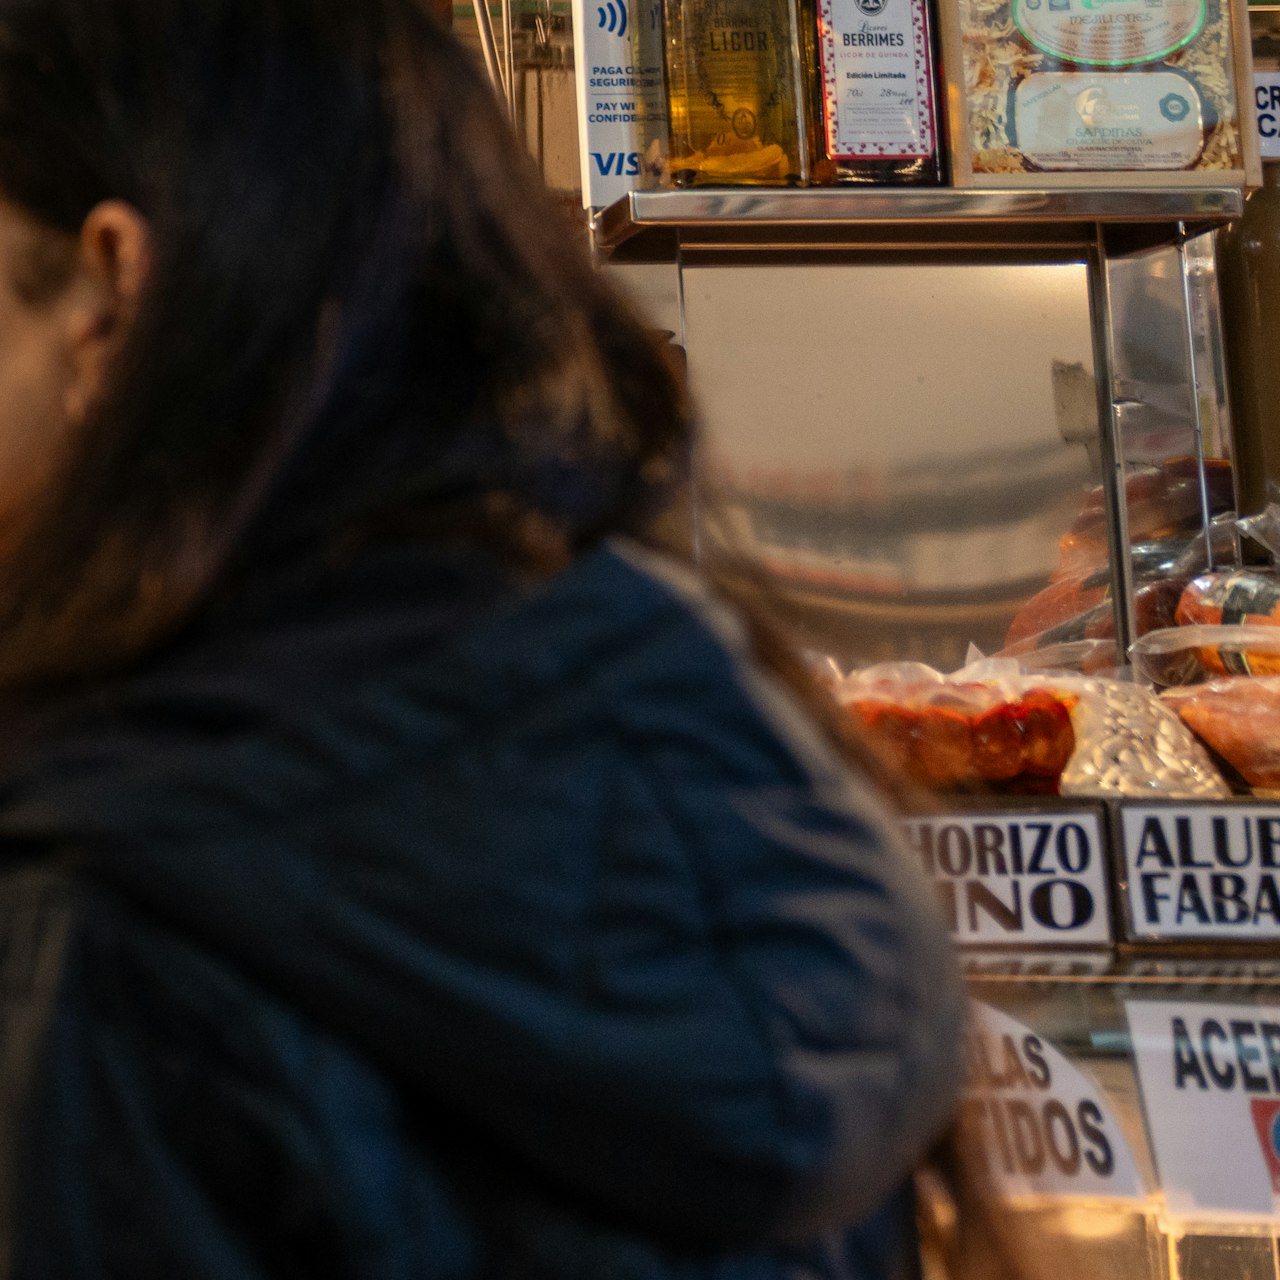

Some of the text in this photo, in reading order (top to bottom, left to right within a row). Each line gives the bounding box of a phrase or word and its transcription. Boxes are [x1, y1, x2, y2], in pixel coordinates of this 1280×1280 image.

[709, 31, 769, 52] LICOR
[843, 33, 905, 46] BERRIMES
[592, 66, 624, 75] PAGA
[596, 102, 621, 111] PAY
